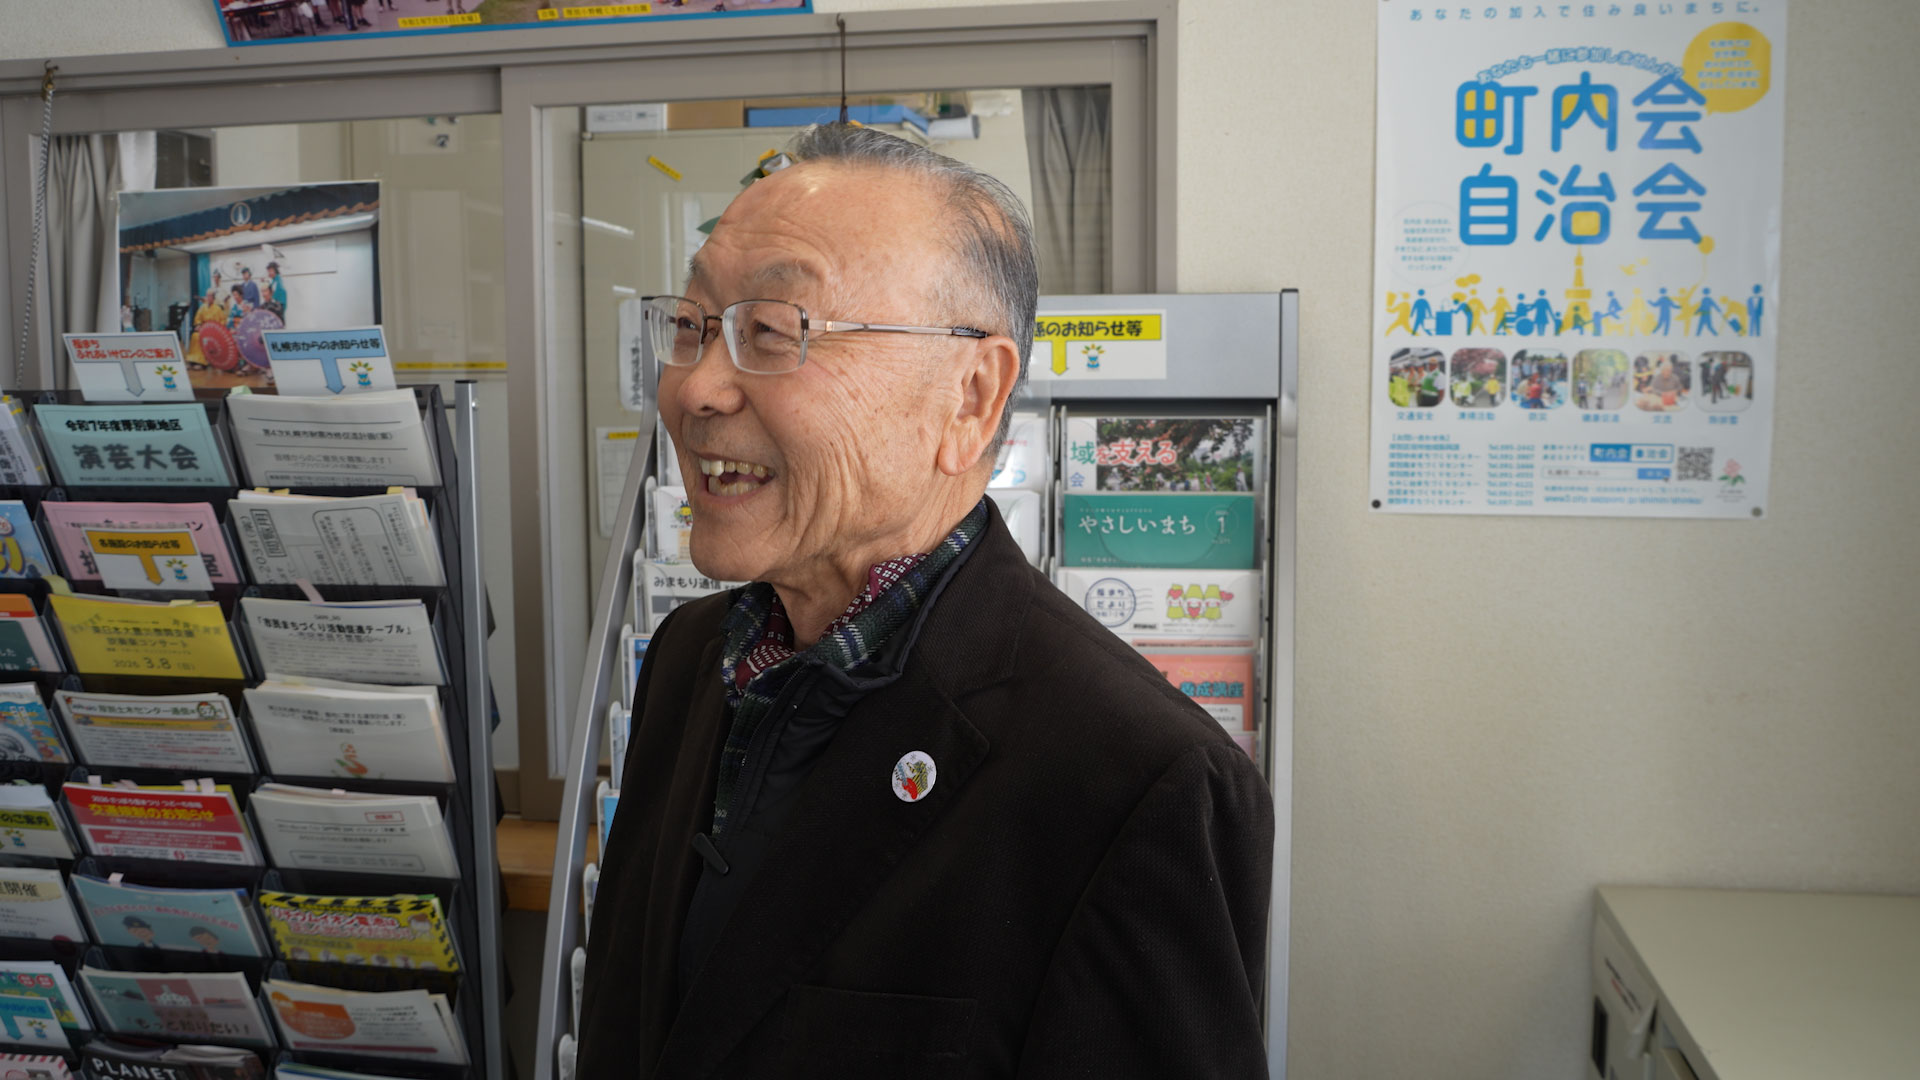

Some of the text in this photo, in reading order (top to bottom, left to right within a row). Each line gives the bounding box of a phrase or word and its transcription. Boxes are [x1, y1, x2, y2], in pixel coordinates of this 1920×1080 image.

[1409, 2, 1761, 21] あなたの加入で住み良いまちに。
[1456, 71, 1707, 155] 町内会
[1459, 162, 1707, 245] 自治会
[1034, 320, 1143, 337] 係のお知らせ等
[271, 338, 380, 352] 札幌市からのお知らせ等
[65, 418, 183, 432] 令和7年度厚別東地区
[72, 443, 200, 470] 演芸大会
[1070, 441, 1176, 465] 域を支える
[1070, 472, 1084, 487] 会
[1078, 516, 1195, 534] やさしいまち
[654, 576, 721, 590] みまもり通信
[1097, 600, 1125, 608] だより
[143, 657, 172, 670] 3.8
[1180, 681, 1244, 698] 養成講座
[92, 1057, 178, 1080] PLANET
